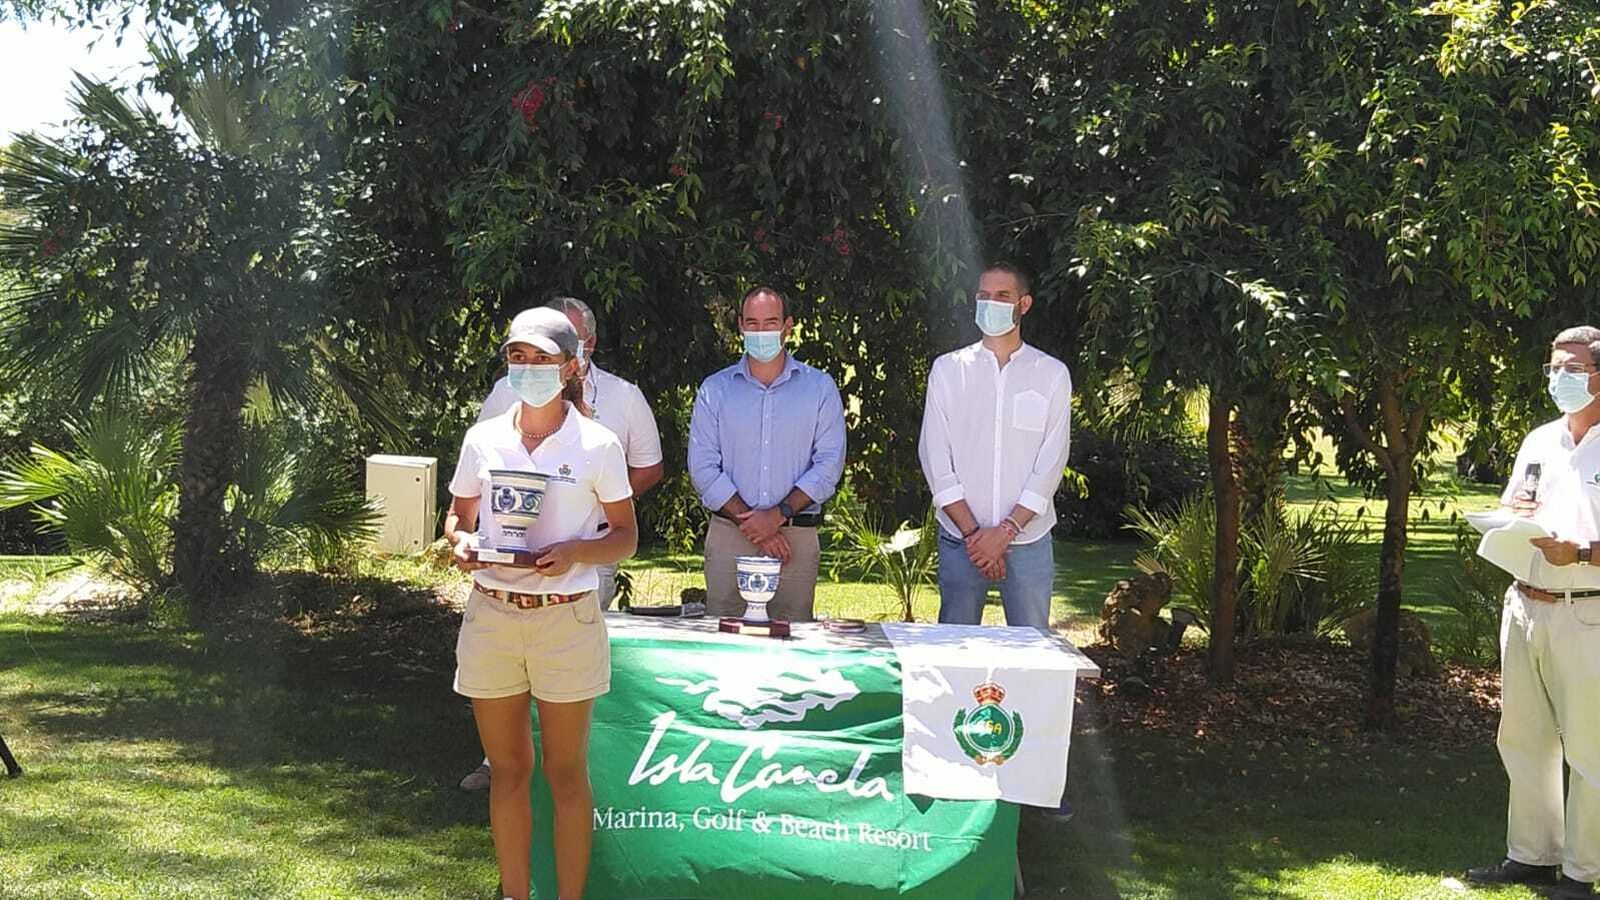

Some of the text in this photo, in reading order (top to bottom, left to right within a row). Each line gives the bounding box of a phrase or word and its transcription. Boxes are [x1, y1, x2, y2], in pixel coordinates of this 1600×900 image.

[628, 710, 896, 803] Isla Canela
[593, 806, 932, 852] Marina, Golf & Beach Resort
